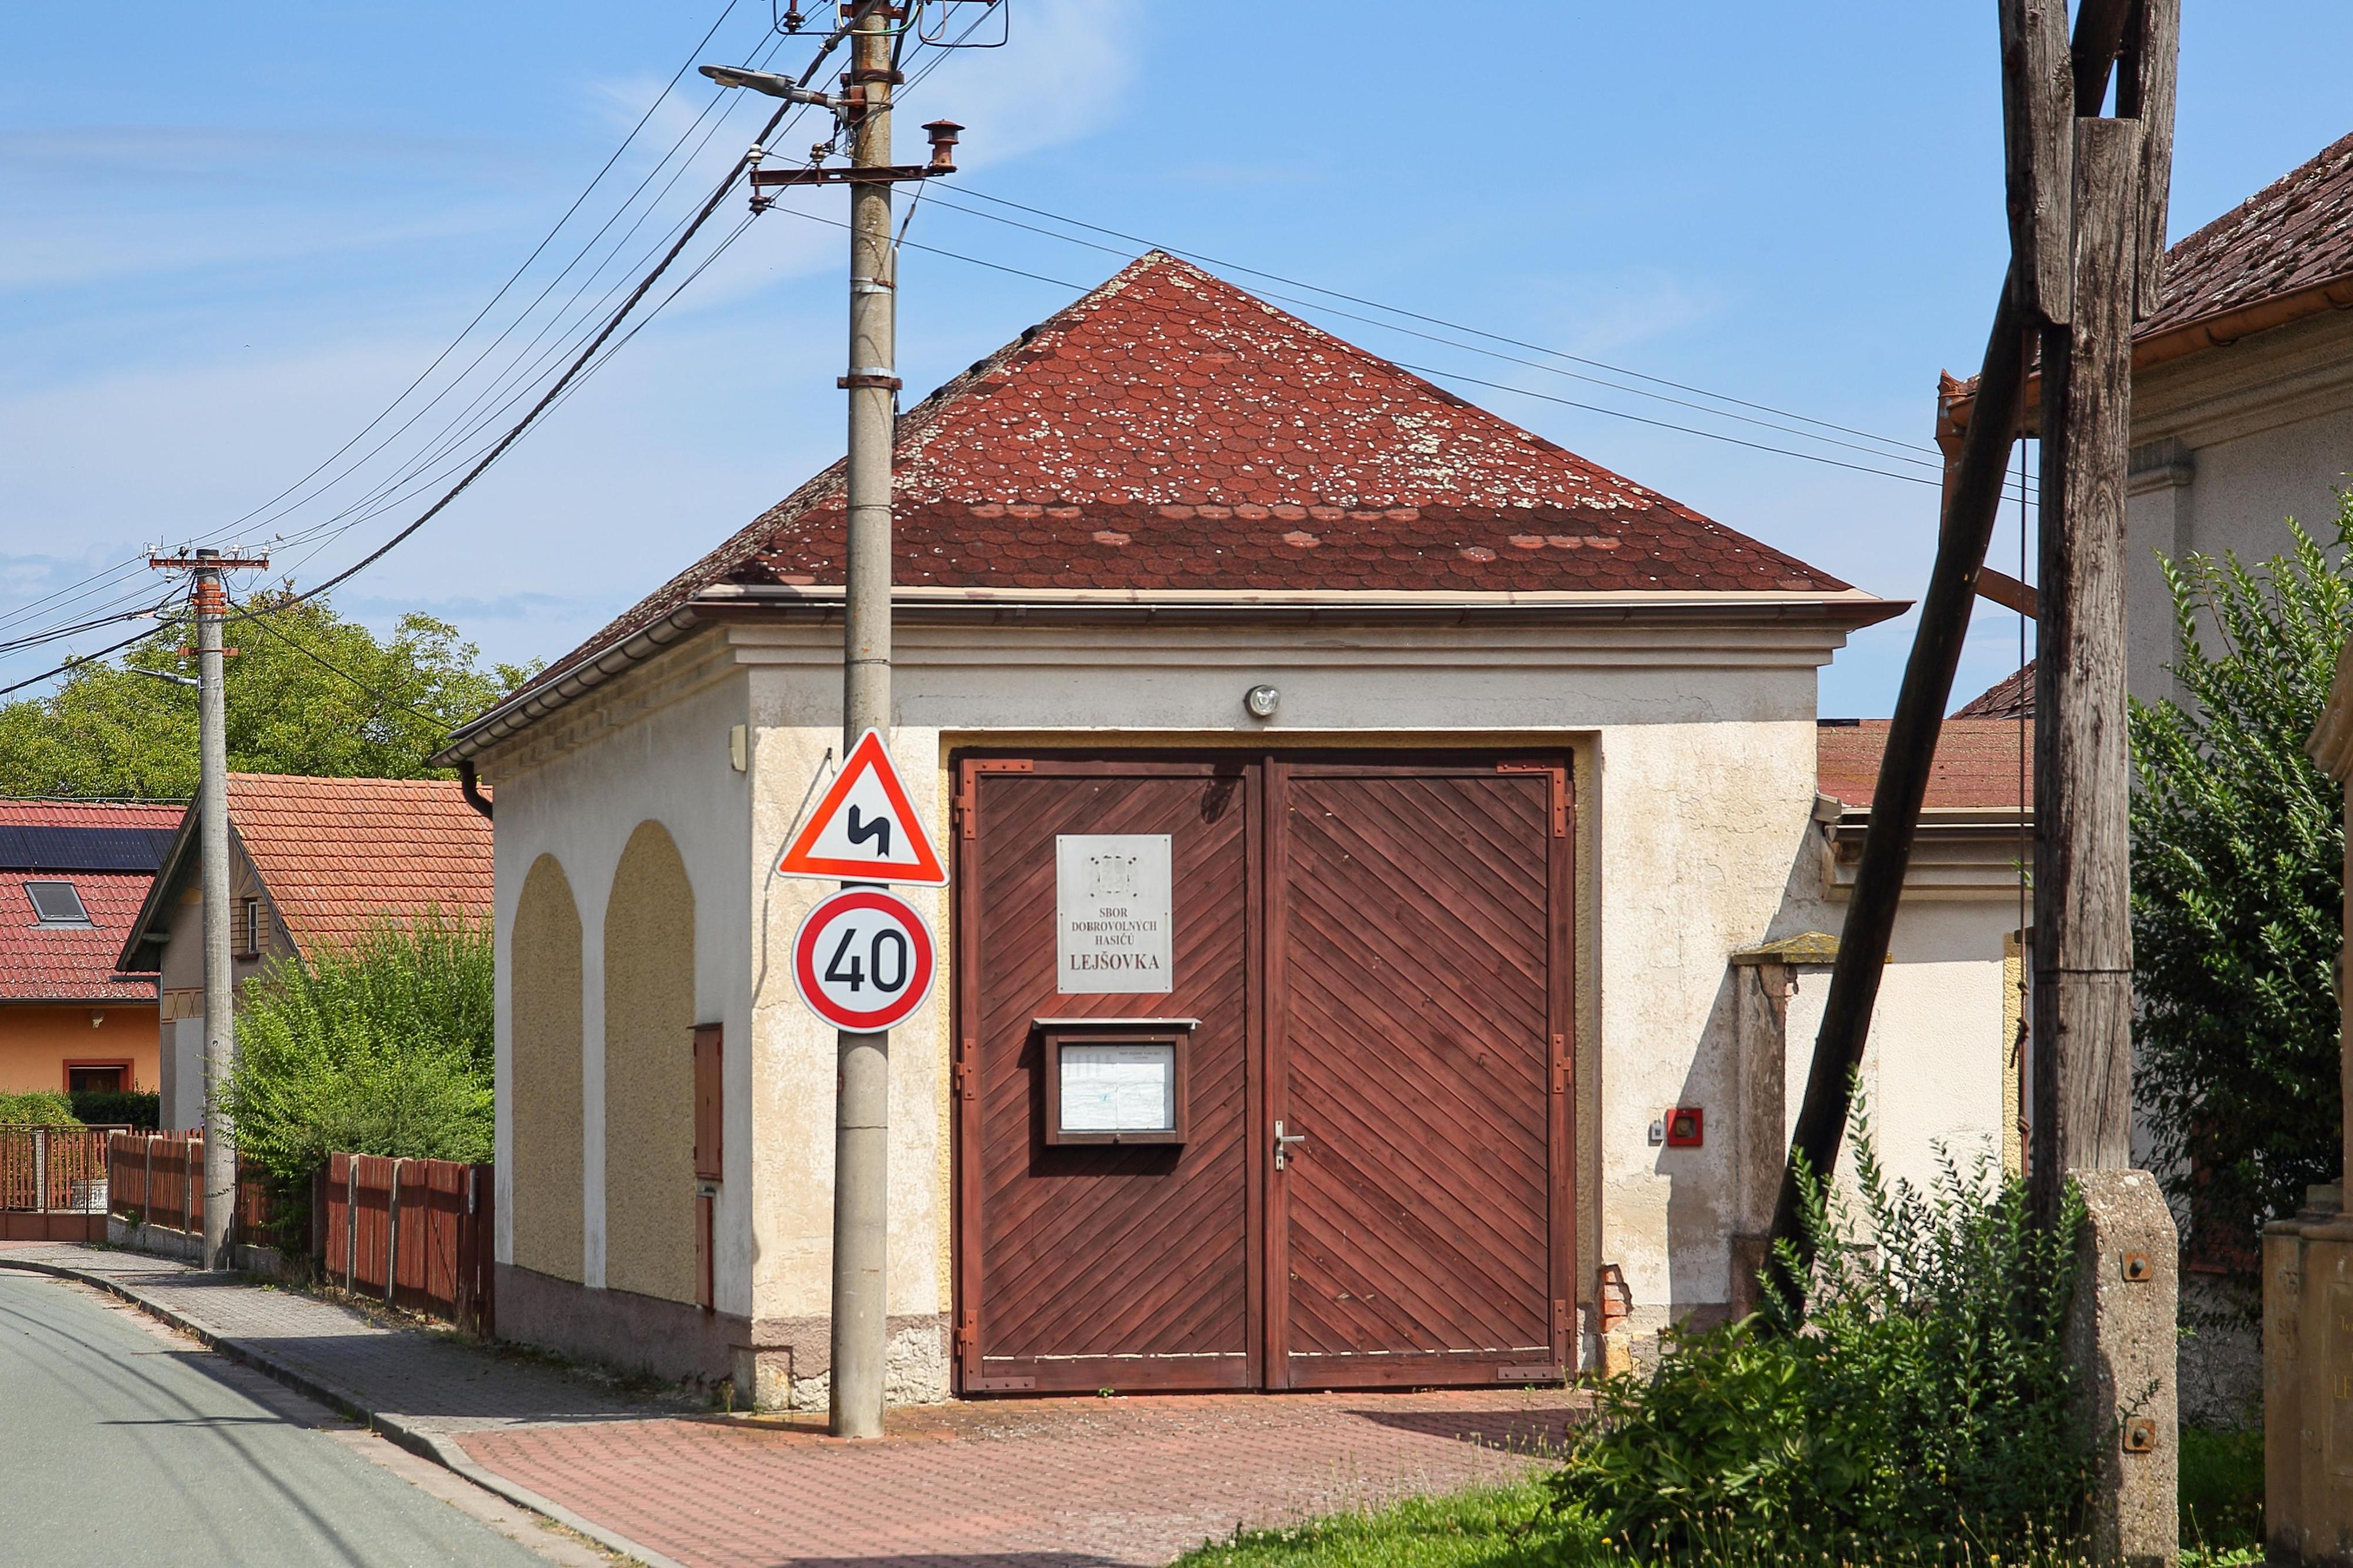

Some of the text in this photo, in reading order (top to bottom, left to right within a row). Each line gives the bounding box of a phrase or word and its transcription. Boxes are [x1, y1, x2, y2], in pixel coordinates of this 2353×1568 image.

[1099, 908, 1128, 918] SBOR
[1072, 920, 1157, 932] DOBROVOLNÝCH
[825, 928, 906, 992] 40
[1070, 951, 1160, 970] LEJŠOVKA
